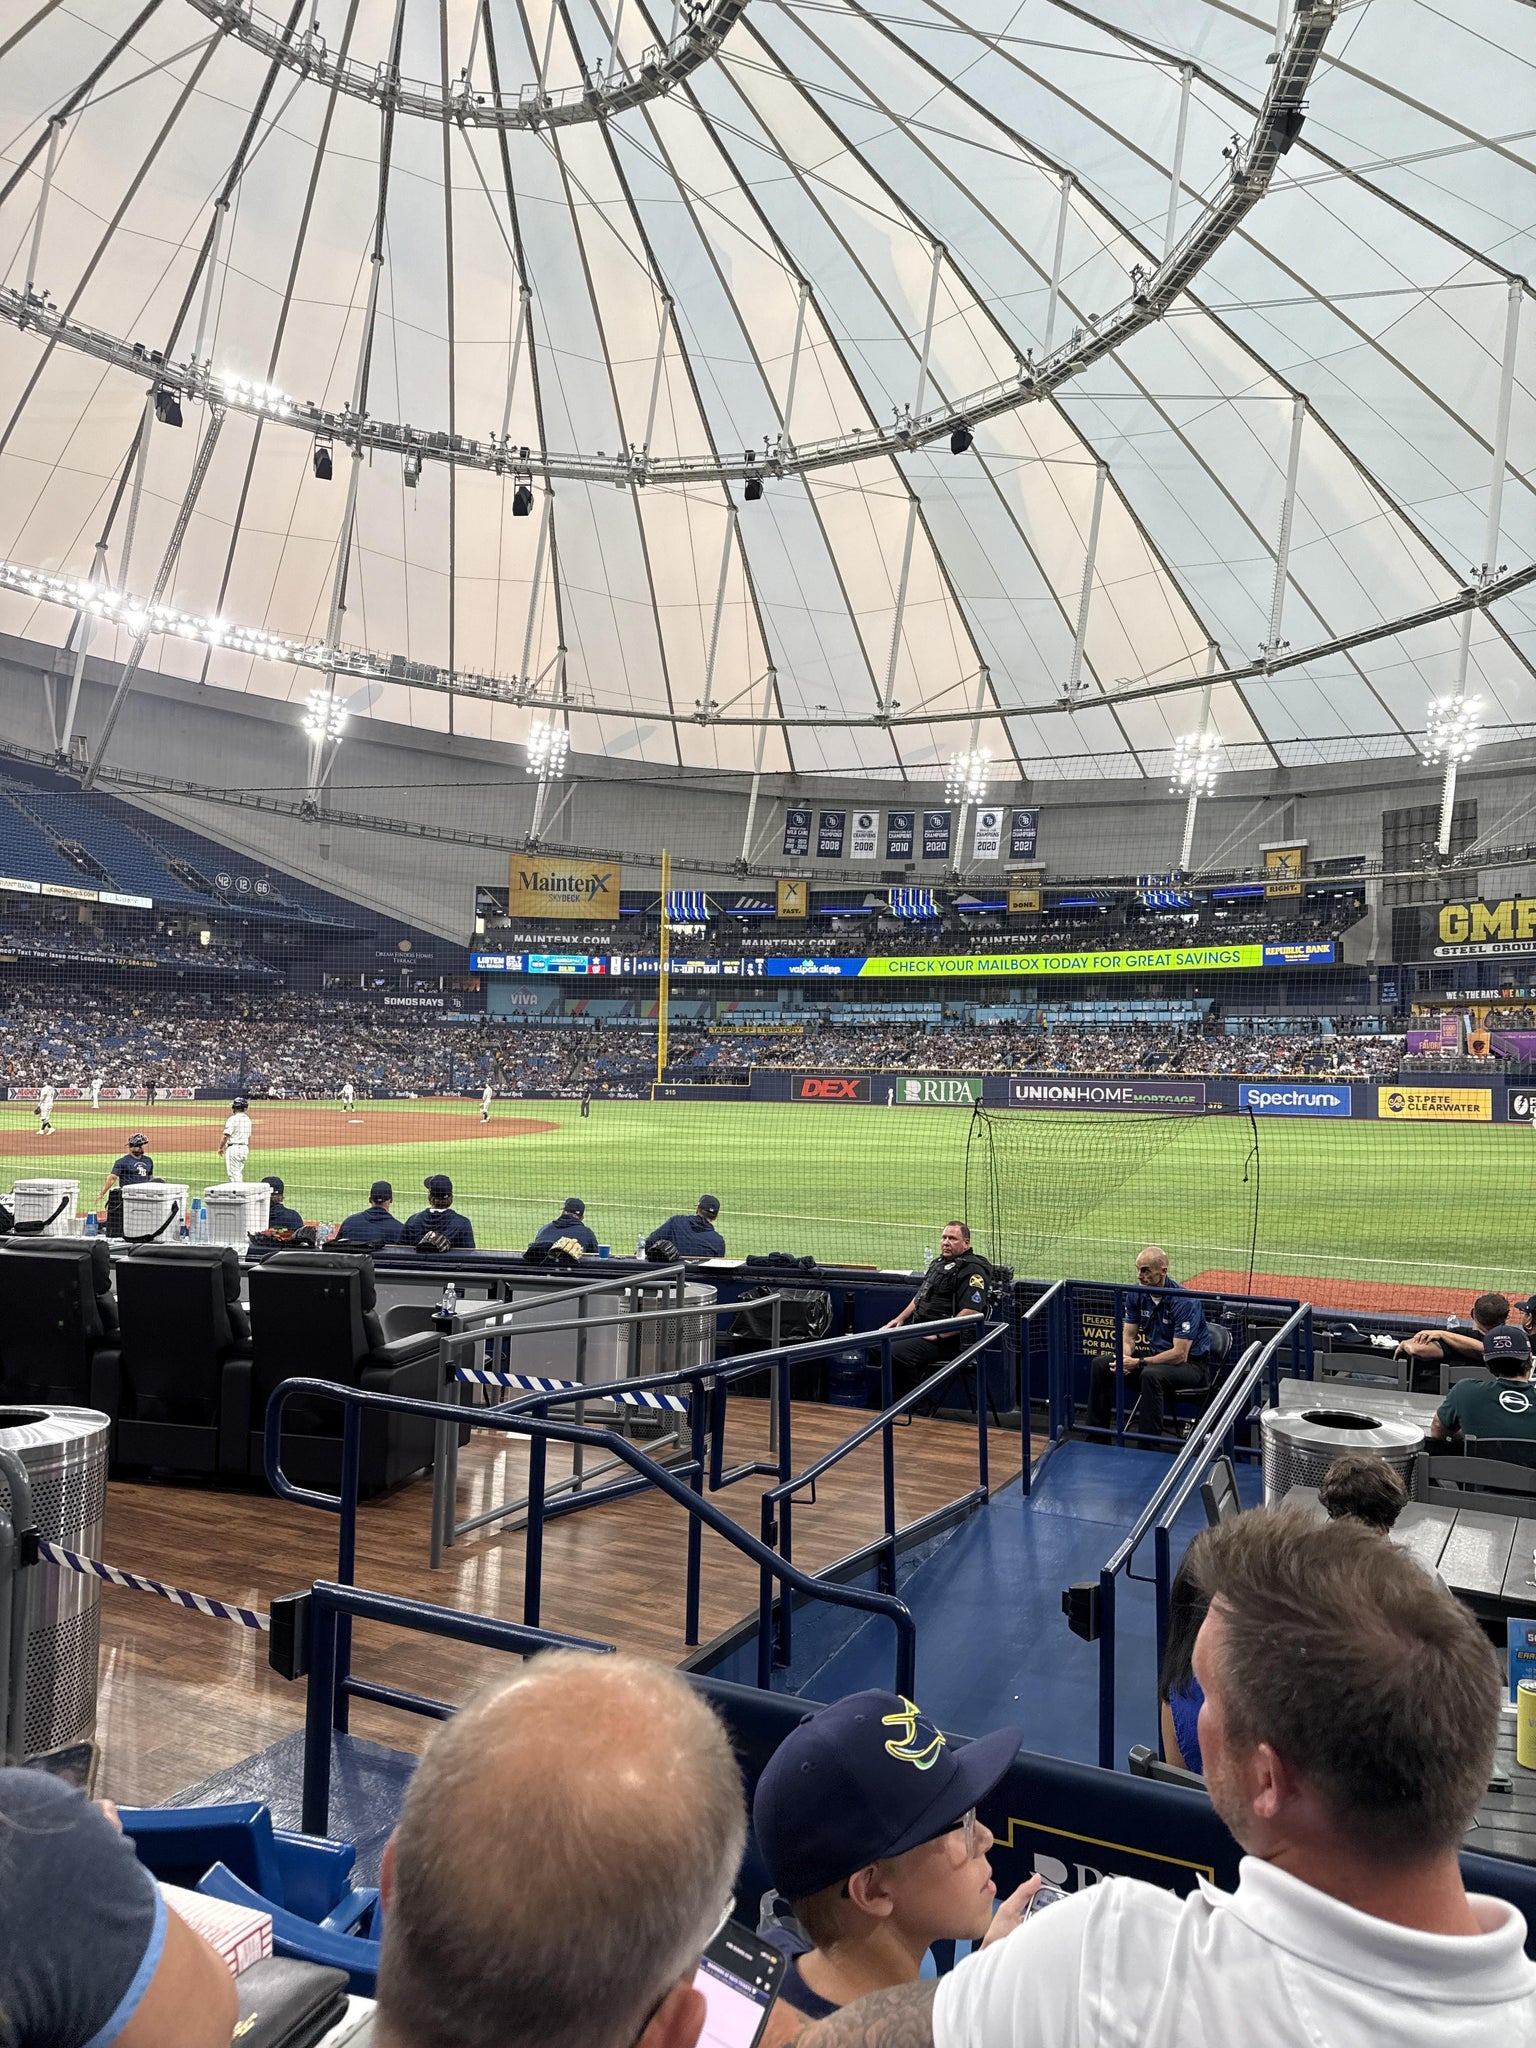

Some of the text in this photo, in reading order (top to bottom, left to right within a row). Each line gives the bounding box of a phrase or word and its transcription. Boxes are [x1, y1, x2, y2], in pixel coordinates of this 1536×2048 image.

[820, 841, 839, 851] 2008
[854, 842, 874, 851] 2008
[890, 842, 909, 852] 2010
[926, 841, 947, 851] 2020
[977, 841, 997, 851] 2020
[1014, 841, 1033, 851] 2021
[218, 875, 229, 887] 42
[239, 879, 248, 890] 12
[256, 882, 268, 893] 66
[517, 872, 613, 902] MaintenX
[549, 894, 581, 903] SKYDECK
[514, 935, 611, 945] MAINTENX.COM
[741, 939, 837, 947] MAINTENXCOM
[1265, 944, 1330, 956] REPUBLIC BANK
[1441, 945, 1487, 955] STEEL
[477, 956, 505, 964] LISTEN
[888, 950, 1240, 972] CHECK YOUR MAILBOX TODAY FOR GREAT SAVINGS
[511, 993, 538, 1005] VIVA
[1446, 991, 1457, 1000] WE
[1465, 990, 1480, 999] THE
[1481, 989, 1502, 999] RAYS.
[801, 1079, 861, 1098] DEX
[923, 1080, 975, 1103] RIPA
[1247, 1089, 1334, 1108] Spectrum
[1408, 1103, 1480, 1112] CLEARWATER
[1086, 1317, 1115, 1326] PLEASE
[1083, 1340, 1099, 1348] FOR
[1083, 1348, 1097, 1356] THE
